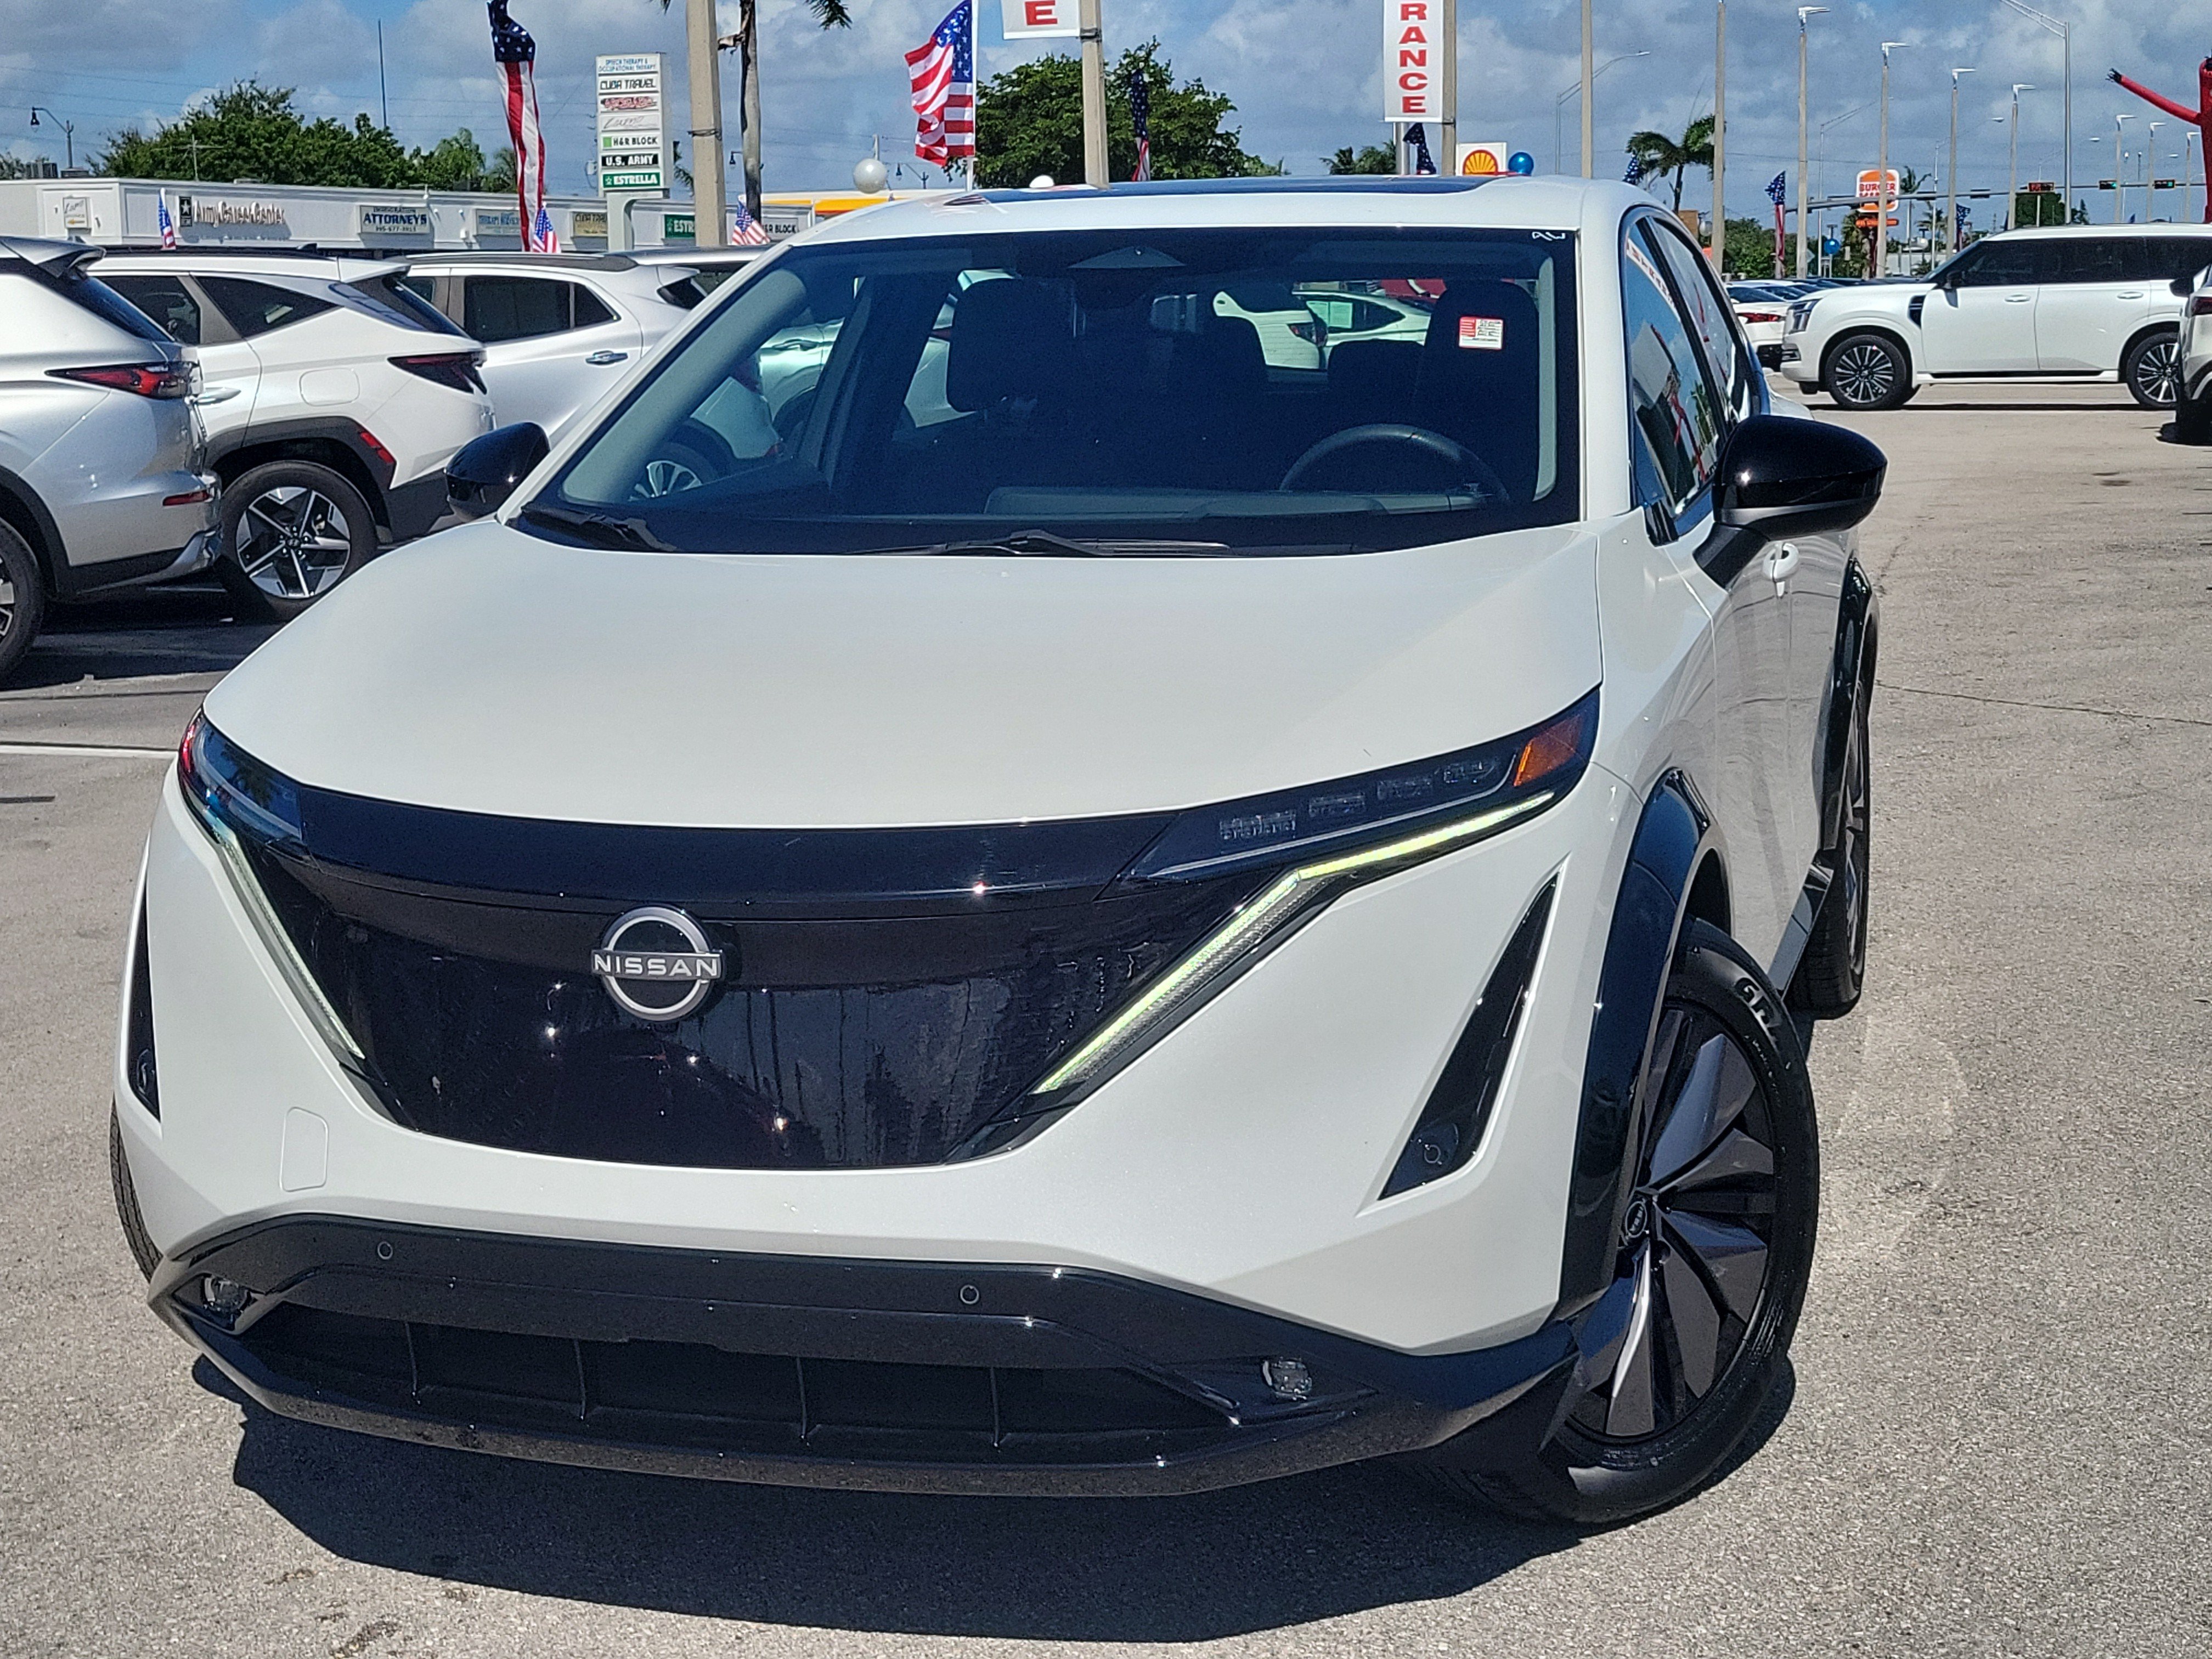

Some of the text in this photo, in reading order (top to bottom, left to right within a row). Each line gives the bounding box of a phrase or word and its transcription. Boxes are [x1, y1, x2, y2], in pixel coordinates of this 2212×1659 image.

[1025, 1, 1057, 25] E
[624, 78, 656, 89] TRAVEL
[632, 137, 658, 145] BLOCK
[606, 155, 654, 165] U.S. ARMY
[613, 174, 657, 185] ESTRELLA
[194, 200, 219, 228] Army
[218, 201, 251, 224] Career
[251, 202, 285, 224] Center
[363, 213, 427, 224] ATTORNEYS
[775, 224, 796, 233] BLOCK
[594, 954, 717, 977] NISSAN
